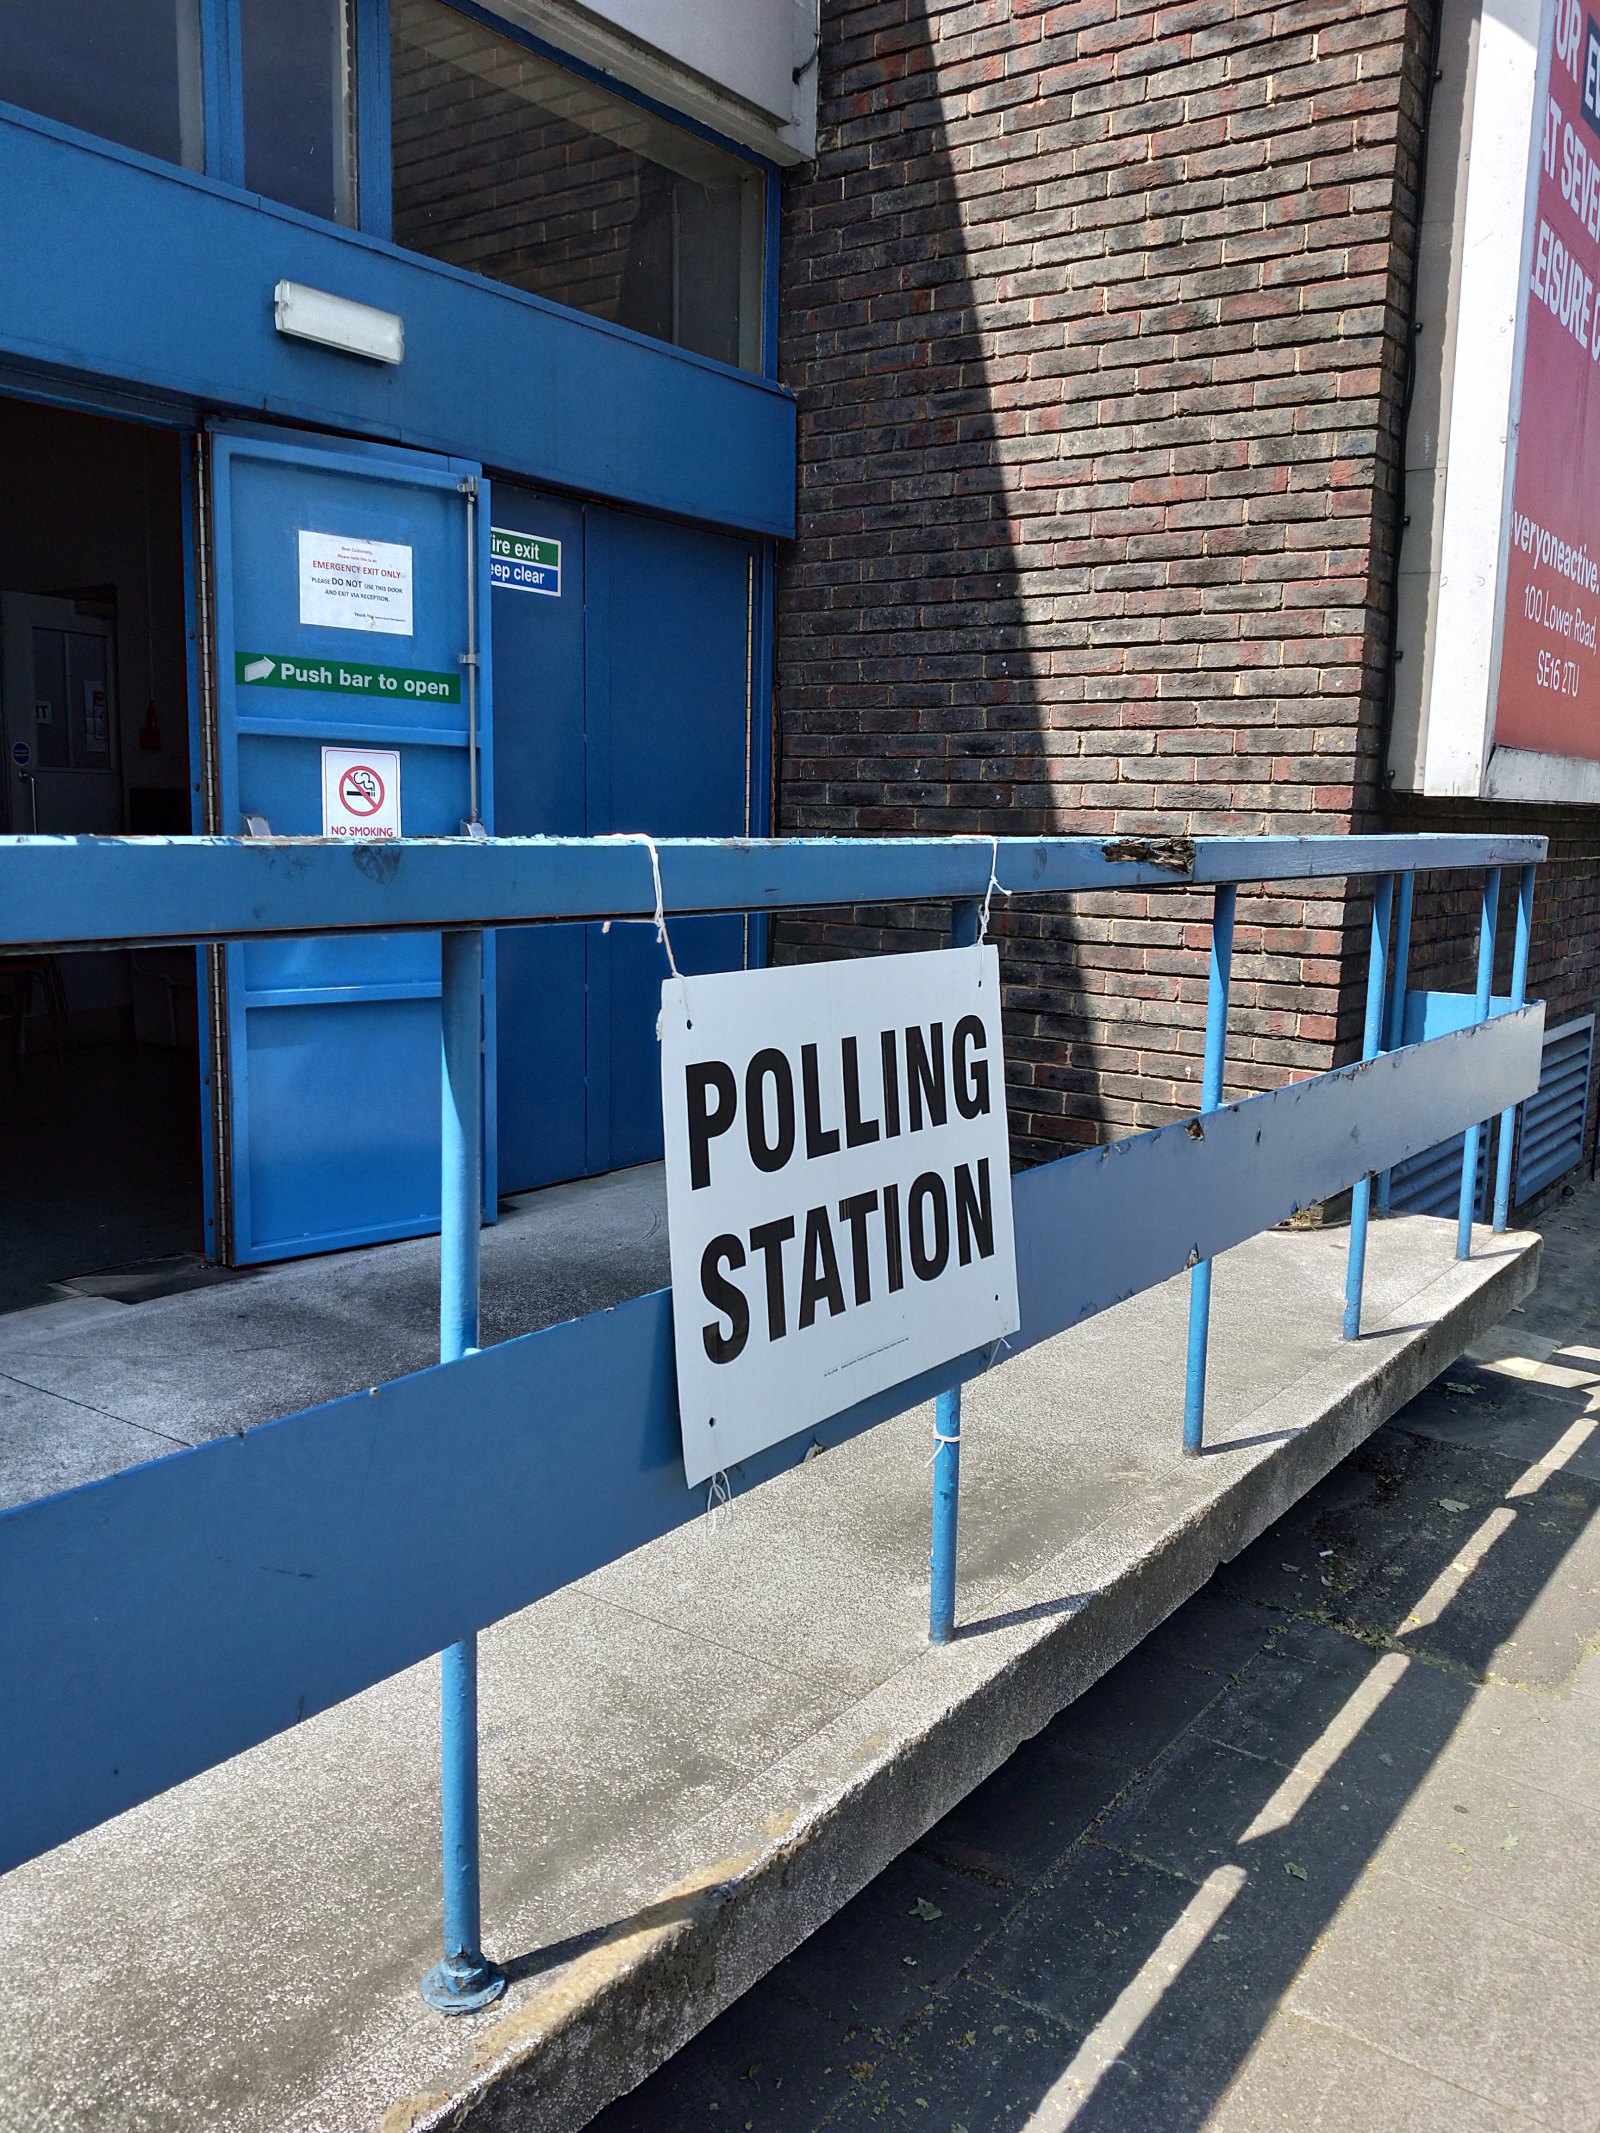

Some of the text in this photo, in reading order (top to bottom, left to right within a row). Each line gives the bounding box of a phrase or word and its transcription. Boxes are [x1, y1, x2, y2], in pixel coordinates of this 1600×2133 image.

[1555, 0, 1581, 84] UR
[1561, 122, 1600, 244] SEVE
[1531, 219, 1593, 349] EISURE
[312, 560, 401, 579] EMERGENCY EXIT ONLY
[491, 534, 540, 561] ire exit
[514, 565, 545, 585] clear
[1511, 510, 1600, 596] veryoneactive.
[311, 576, 331, 585] PLEASE
[331, 577, 344, 586] DO
[345, 579, 362, 589] NOT
[387, 586, 403, 594] DOOR
[1523, 583, 1597, 657] 100 Lower Road,
[280, 663, 450, 697] Push bar to open
[1536, 649, 1580, 698] SE16 2TU
[331, 825, 393, 838] NO SMOKING
[685, 1014, 991, 1192] POLLING
[700, 1157, 996, 1366] STATION
